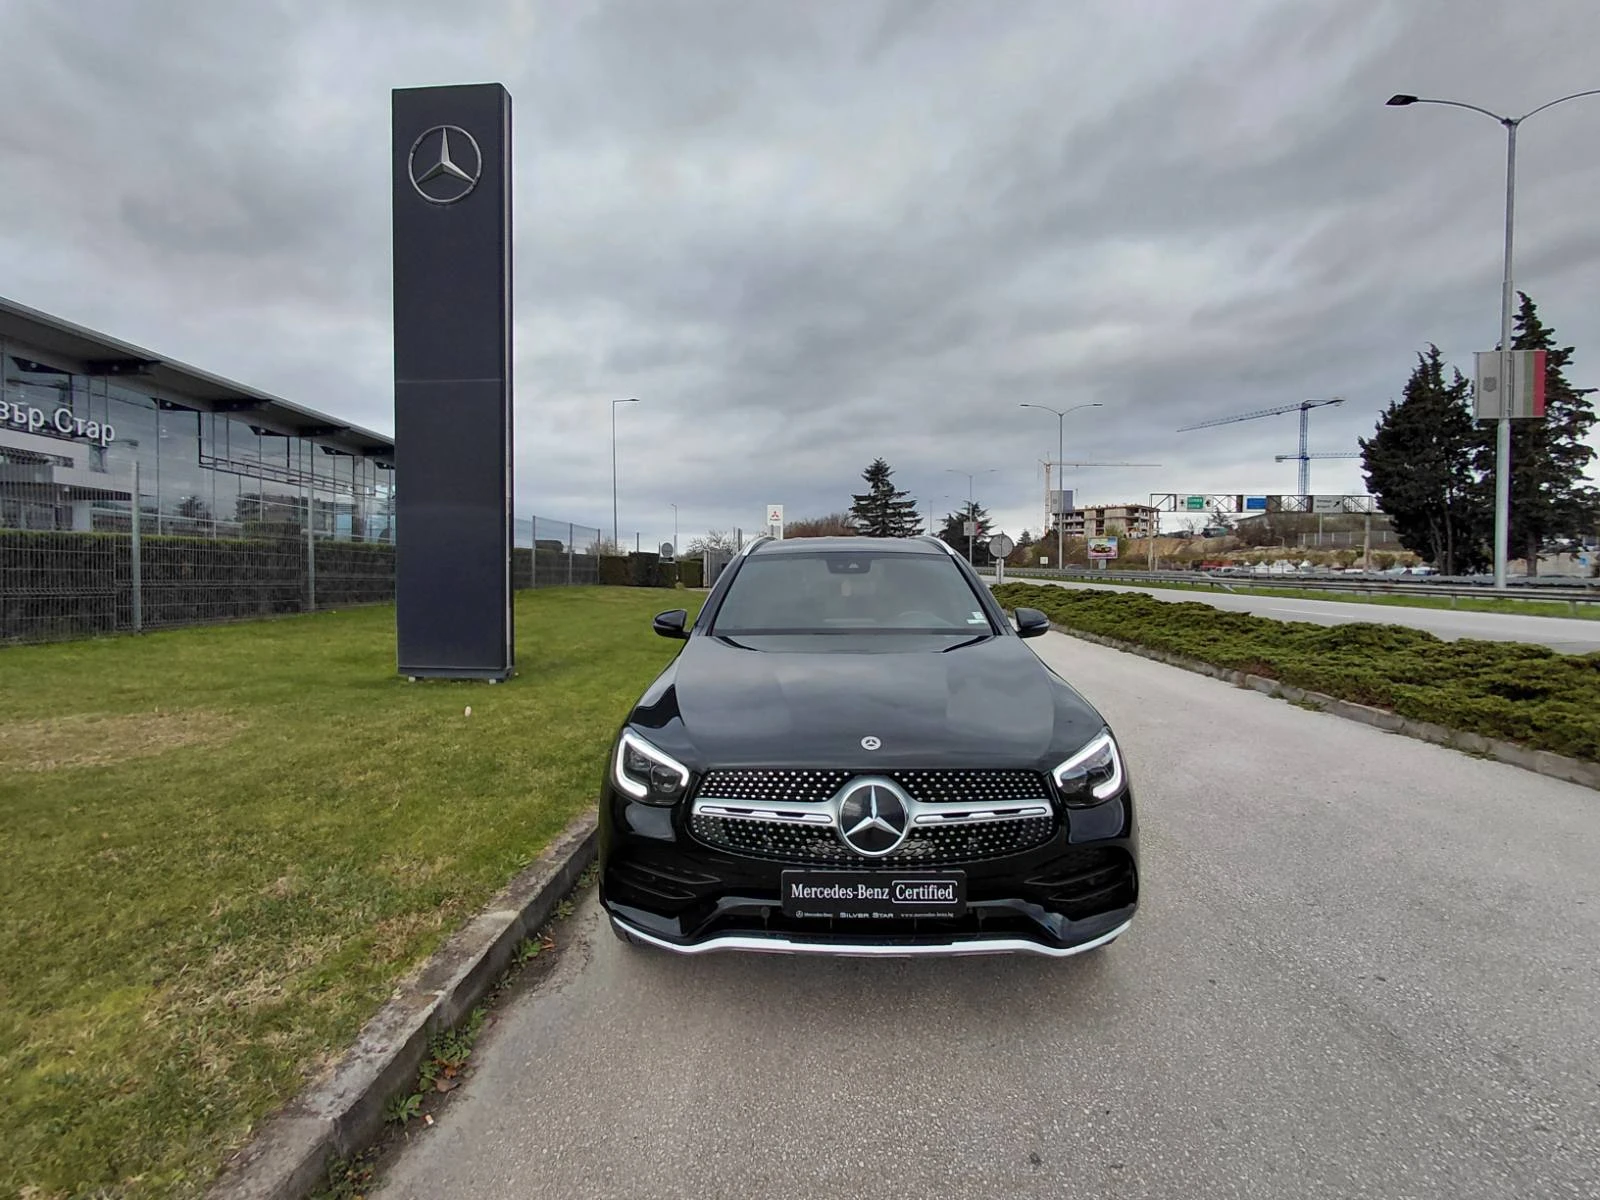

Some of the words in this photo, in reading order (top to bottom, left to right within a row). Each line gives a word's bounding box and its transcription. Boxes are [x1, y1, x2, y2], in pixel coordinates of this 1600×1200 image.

[54, 407, 116, 447] Стар
[791, 883, 889, 899] Mercedes-Benz
[896, 884, 953, 900] Certified
